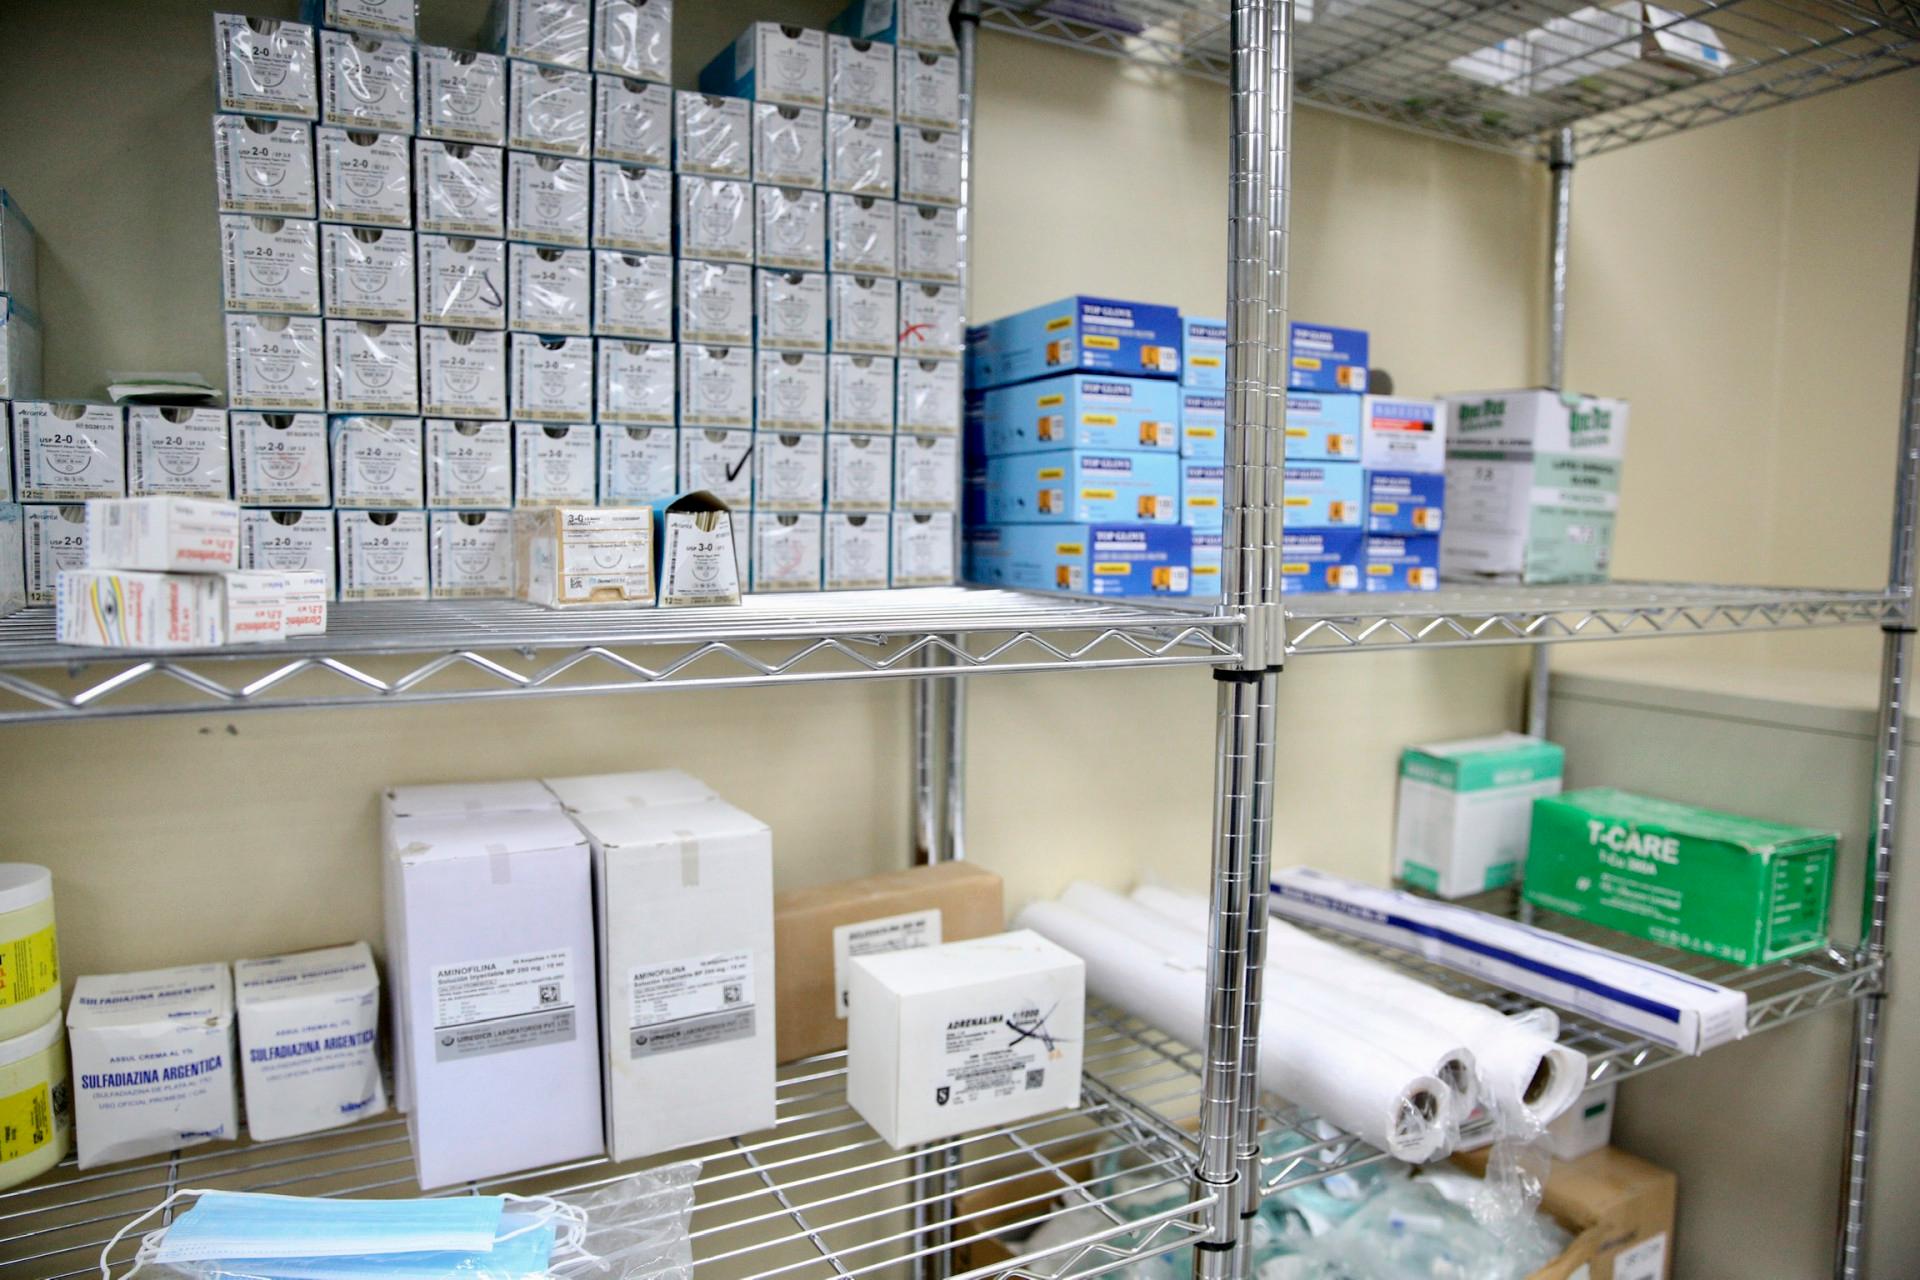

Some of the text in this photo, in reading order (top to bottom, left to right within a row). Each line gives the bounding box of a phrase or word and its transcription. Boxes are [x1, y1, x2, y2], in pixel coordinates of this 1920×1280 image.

[252, 147, 268, 156] 2-0
[353, 158, 368, 168] 2-0
[256, 248, 272, 256] 2-0
[451, 265, 465, 273] 2-0
[262, 344, 278, 353] 2-0
[55, 434, 72, 444] 2-0
[166, 436, 182, 446] 2-0
[268, 442, 284, 451] 2-0
[366, 448, 381, 456] 2-0
[568, 514, 584, 522] 3-0
[64, 536, 82, 546] 2-0
[1096, 532, 1145, 541] TOP GLOVE
[275, 538, 290, 546] 2-0
[374, 538, 388, 546] 2-0
[31, 592, 41, 601] 12
[1588, 819, 1680, 865] T-CARE
[438, 963, 496, 977] AMINOFILINA
[634, 966, 685, 980] AMINOFILINA
[946, 1015, 1003, 1030] ADRENALINA
[250, 1040, 320, 1062] SULFADIAZINA
[139, 1052, 167, 1061] CREMA
[82, 1055, 222, 1090] SULFADIAZINA ARGENTICA
